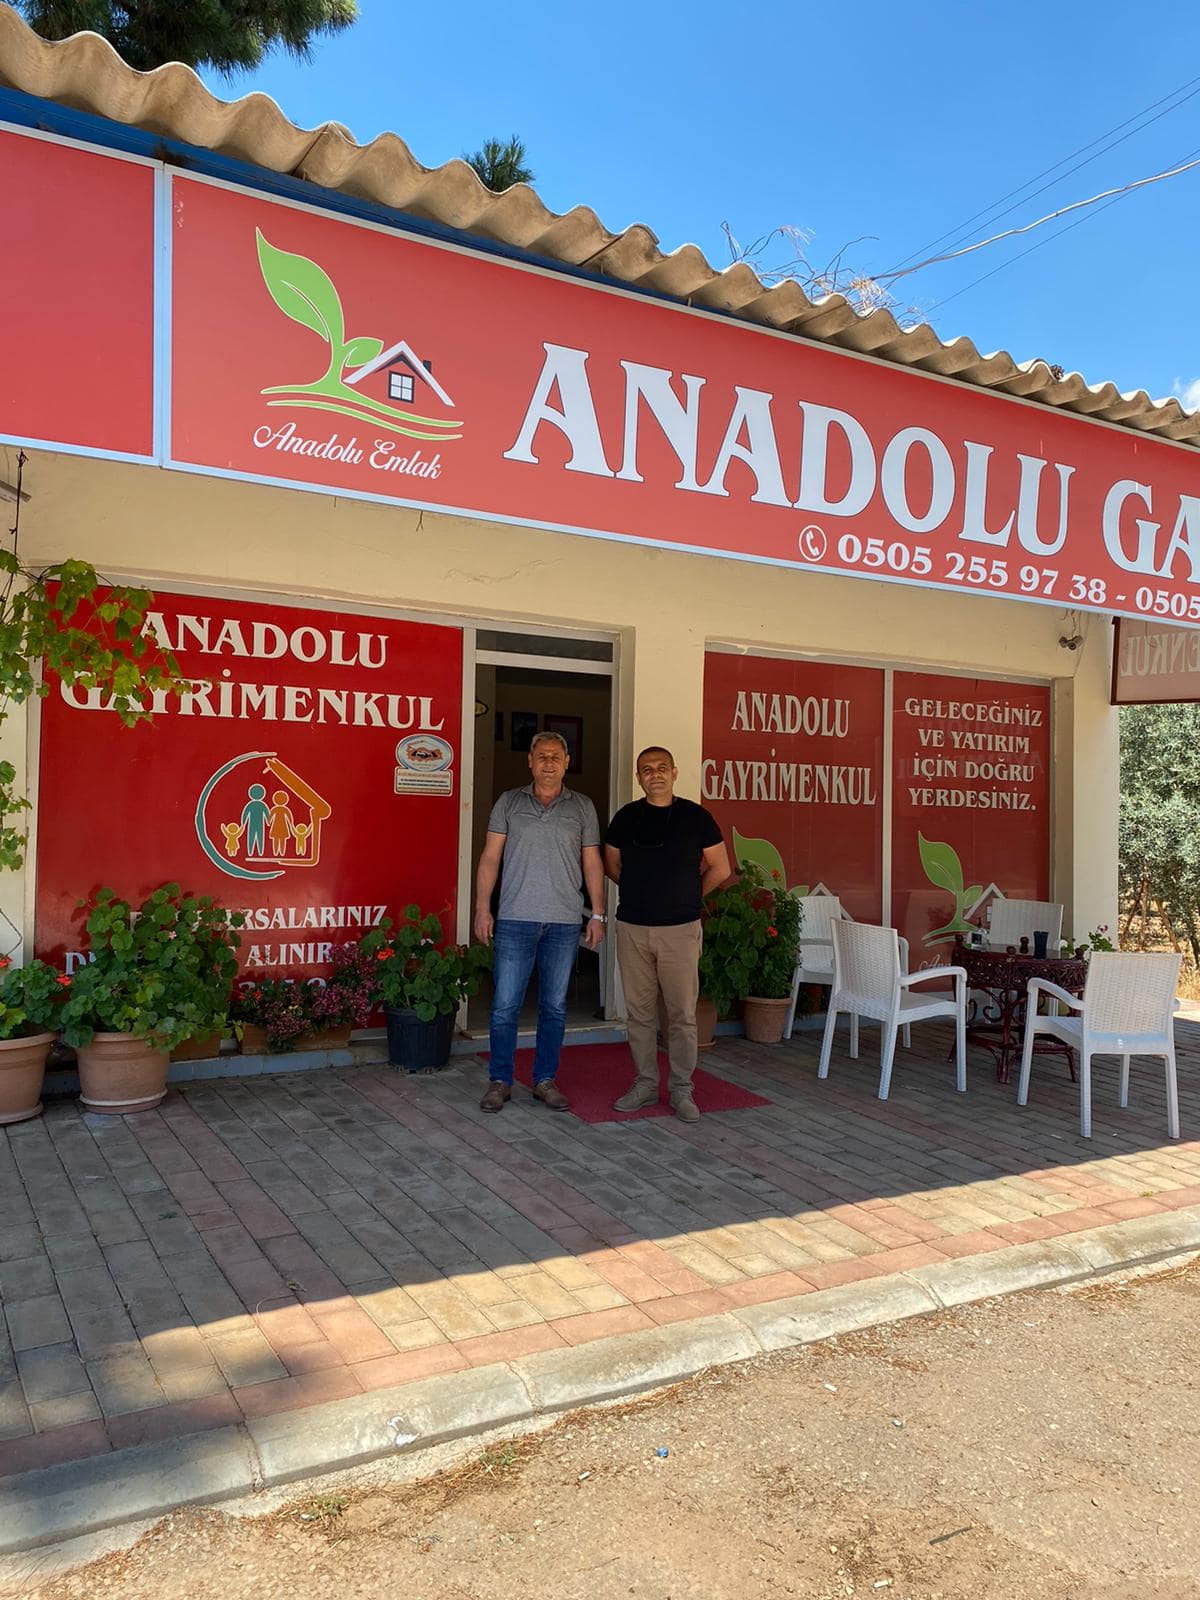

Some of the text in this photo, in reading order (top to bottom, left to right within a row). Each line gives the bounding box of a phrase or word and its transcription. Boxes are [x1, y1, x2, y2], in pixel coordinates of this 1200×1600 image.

[253, 422, 441, 479] Anadolu Emlak
[503, 341, 1200, 584] ANADOLU GA
[838, 533, 932, 575] 0505
[945, 552, 1008, 588] 255
[1019, 565, 1059, 596] 97
[1069, 574, 1106, 604] 38
[1135, 586, 1200, 619] 0505
[132, 611, 389, 668] ANADOLU
[731, 691, 850, 737] ANADOLU
[905, 697, 1043, 727] GELECEĞİNİZ
[918, 728, 1030, 754] VE YATIRIM
[701, 748, 877, 805] GAYRİMENKUL
[913, 752, 1035, 782] İÇİN DOĞRU
[908, 786, 1037, 811] YERDESİNİZ.
